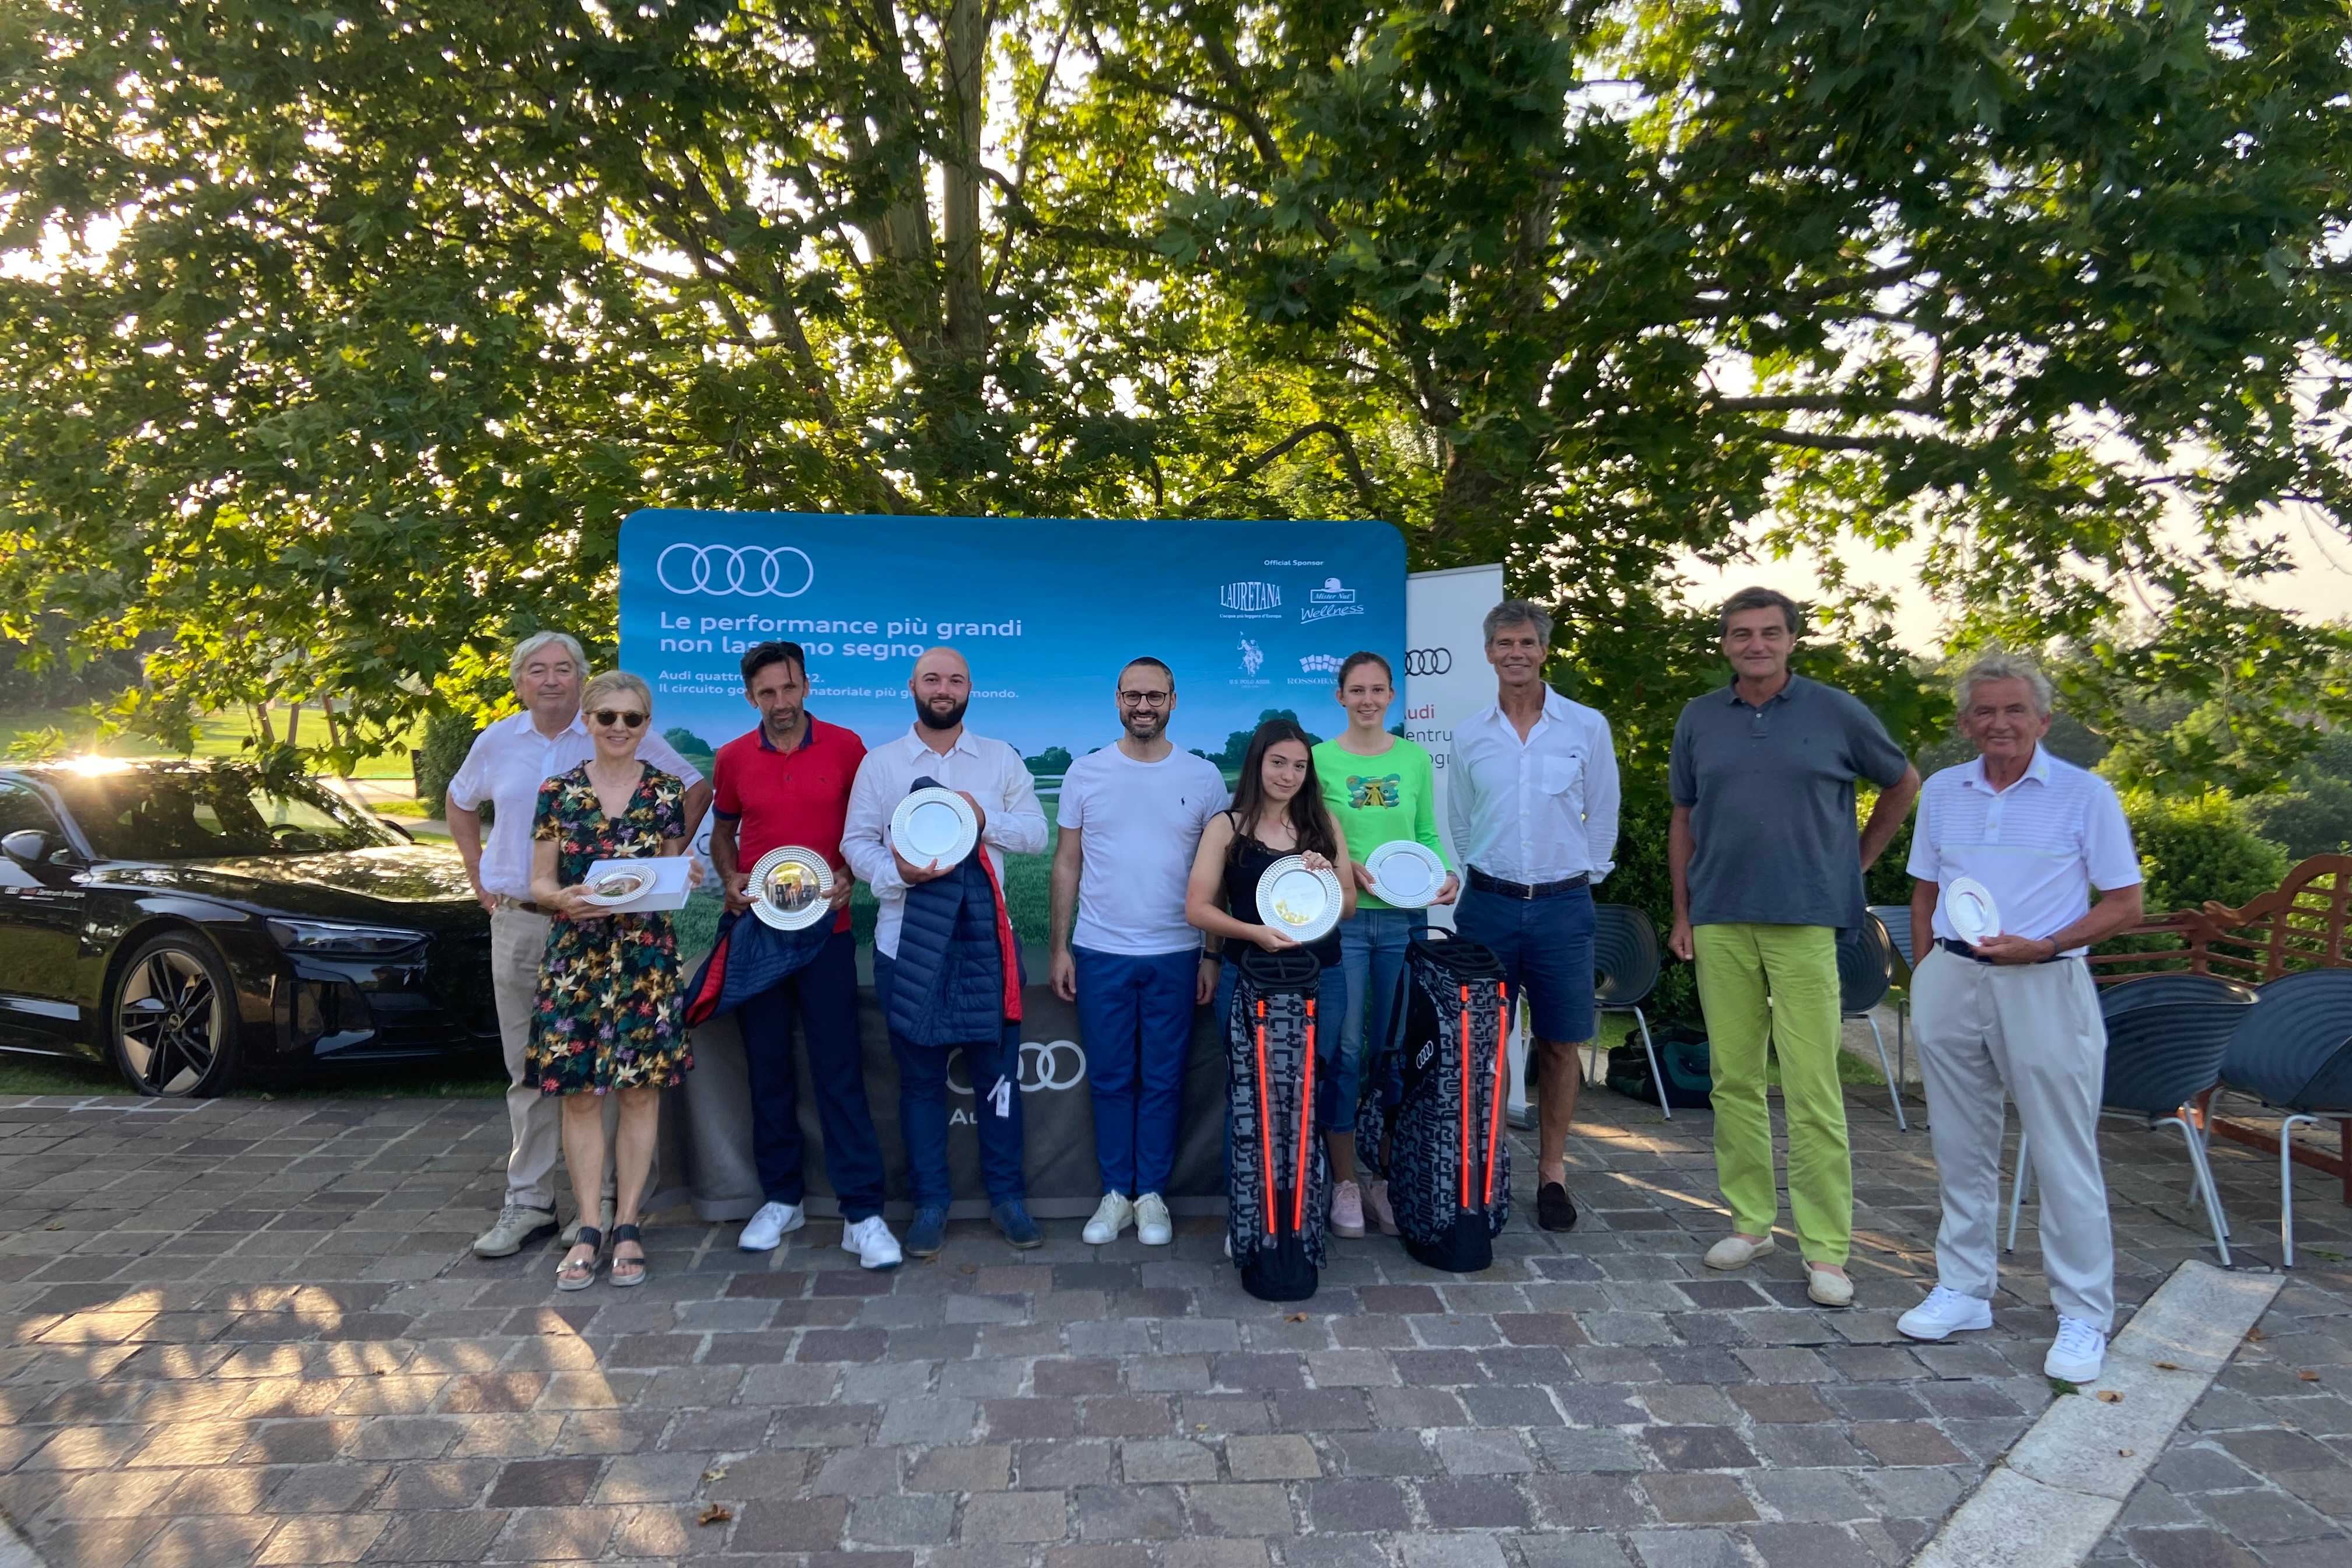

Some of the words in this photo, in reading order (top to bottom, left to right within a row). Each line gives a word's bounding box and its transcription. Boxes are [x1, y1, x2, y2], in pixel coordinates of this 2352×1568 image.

[1220, 582, 1282, 611] LAURETANA
[1300, 604, 1364, 621] Wellness
[660, 611, 691, 629] Le
[701, 614, 878, 635] performance
[887, 617, 928, 638] più
[936, 619, 1021, 639] grandi
[660, 638, 713, 653] non
[659, 670, 691, 680] Audi
[659, 683, 667, 693] Il
[671, 684, 723, 694] circuito
[809, 687, 872, 696] matoriale
[875, 688, 897, 699] più
[1405, 704, 1434, 720] udi
[1405, 729, 1452, 742] entru
